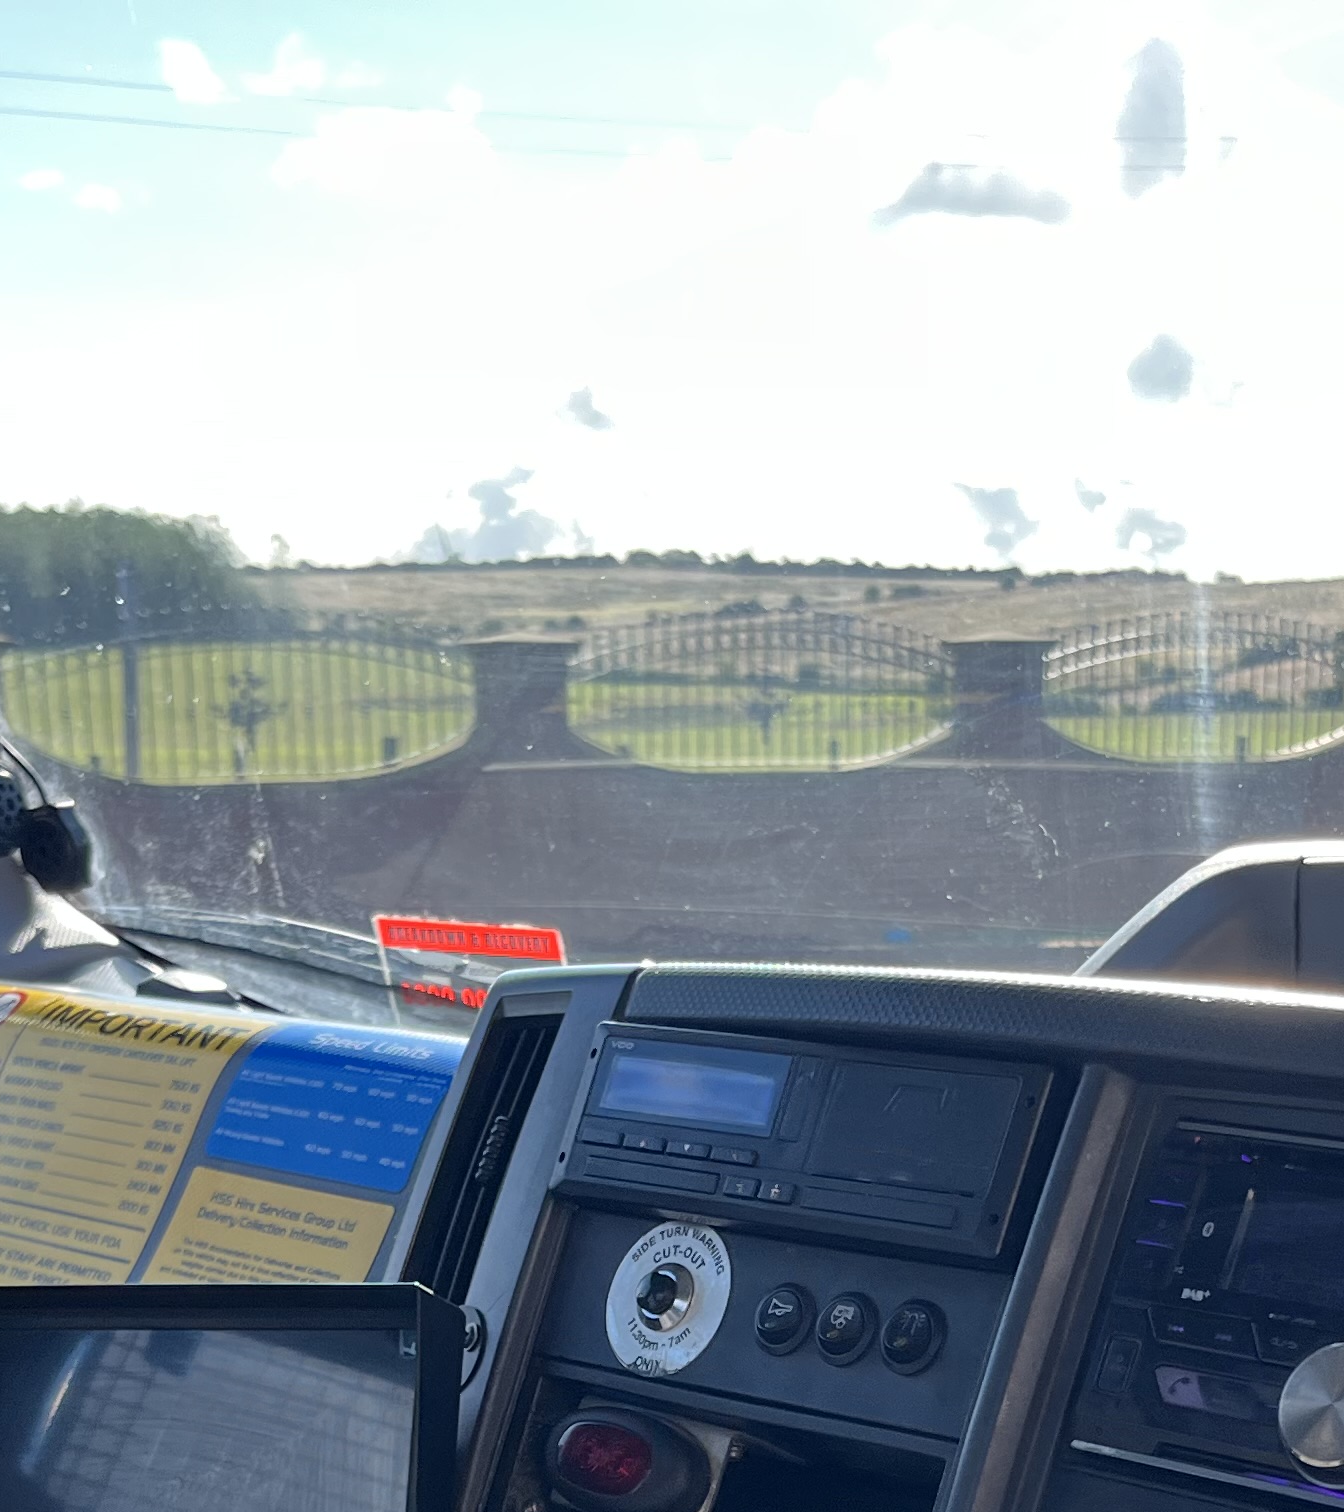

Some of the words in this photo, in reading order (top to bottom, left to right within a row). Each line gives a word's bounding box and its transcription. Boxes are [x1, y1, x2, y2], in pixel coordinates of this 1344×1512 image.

[40, 997, 250, 1053] IMPORTANT
[308, 1032, 373, 1052] Speed
[374, 1040, 435, 1061] Limits
[611, 1040, 635, 1050] VDO
[210, 1190, 235, 1207] HSS
[235, 1197, 256, 1212] Hire
[257, 1201, 303, 1221] Services
[303, 1211, 336, 1229] Group
[337, 1218, 358, 1233] Ltd
[73, 1227, 100, 1244] YOUR
[288, 1226, 349, 1250] Information
[5, 1246, 37, 1263] STAFF
[36, 1255, 57, 1271] ARE
[57, 1260, 112, 1282] PERMITTED
[631, 1235, 657, 1263] SIDE
[659, 1226, 689, 1241] TURN
[691, 1227, 725, 1277] WARNING
[652, 1244, 707, 1270] CUT-OUT
[8, 1265, 31, 1280] THIS
[627, 1317, 659, 1350] 11.30pm
[667, 1327, 691, 1349] 7am
